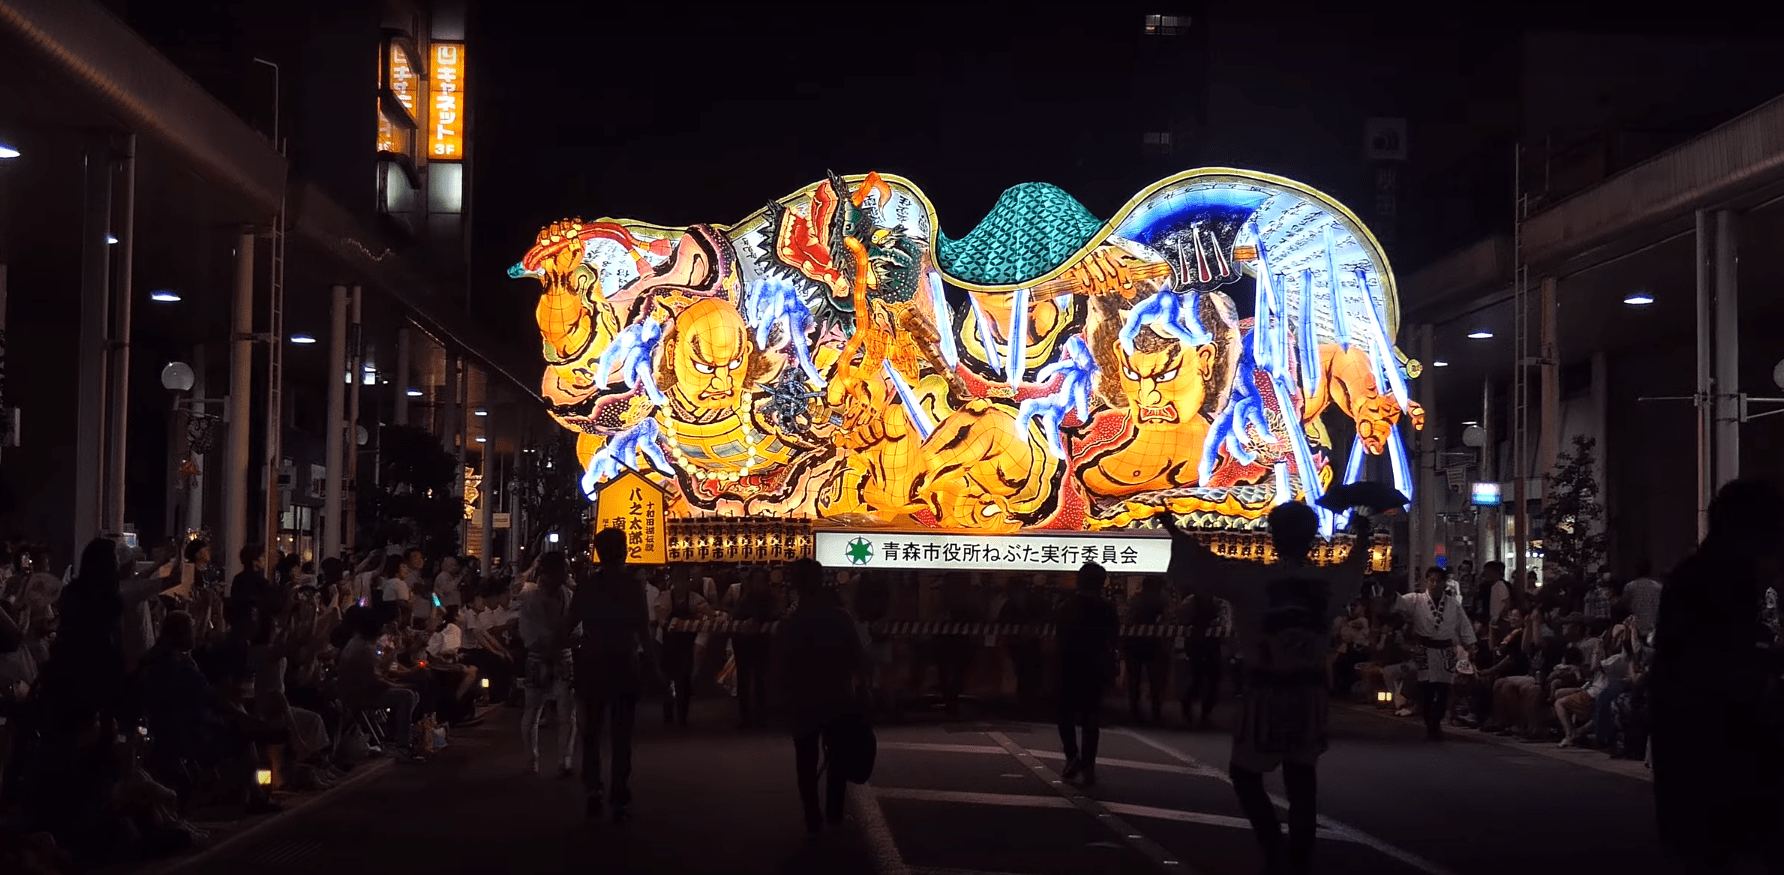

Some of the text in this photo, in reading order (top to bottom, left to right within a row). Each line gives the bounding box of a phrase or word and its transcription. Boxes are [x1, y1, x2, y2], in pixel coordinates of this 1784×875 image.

[436, 67, 457, 140] キャネット
[434, 143, 455, 155] 3F
[882, 541, 1138, 564] 青森市役所ねぶた実行委員会
